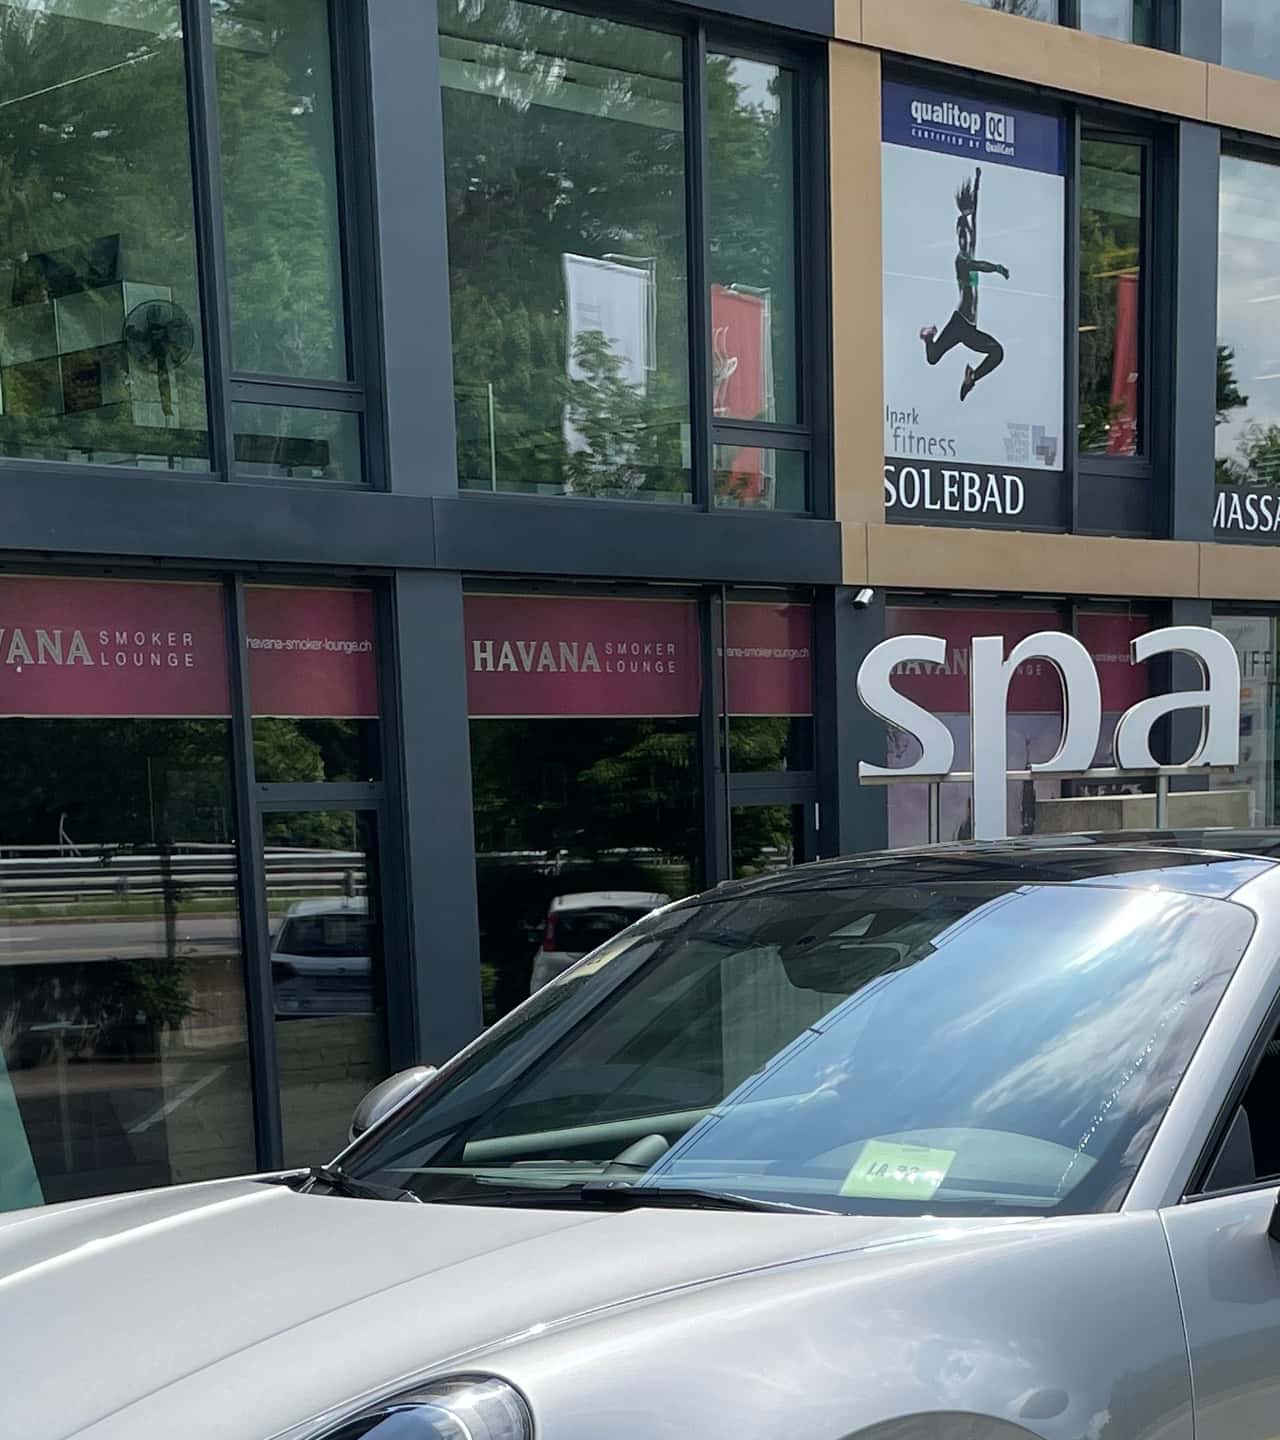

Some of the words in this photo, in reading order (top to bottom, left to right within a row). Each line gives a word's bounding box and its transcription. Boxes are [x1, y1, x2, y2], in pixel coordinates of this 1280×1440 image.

[911, 100, 981, 135] qualitop
[893, 426, 957, 457] fitness
[883, 466, 1025, 514] SOLEBAD
[99, 631, 194, 646] SMOKER
[246, 635, 373, 655] havana-smoker-lounge.ch
[99, 651, 195, 668] LOUNGE
[471, 639, 602, 673] HAVANA
[605, 642, 676, 656] SMOKER
[605, 660, 676, 674] LOUNGE
[856, 626, 1241, 841] spa
